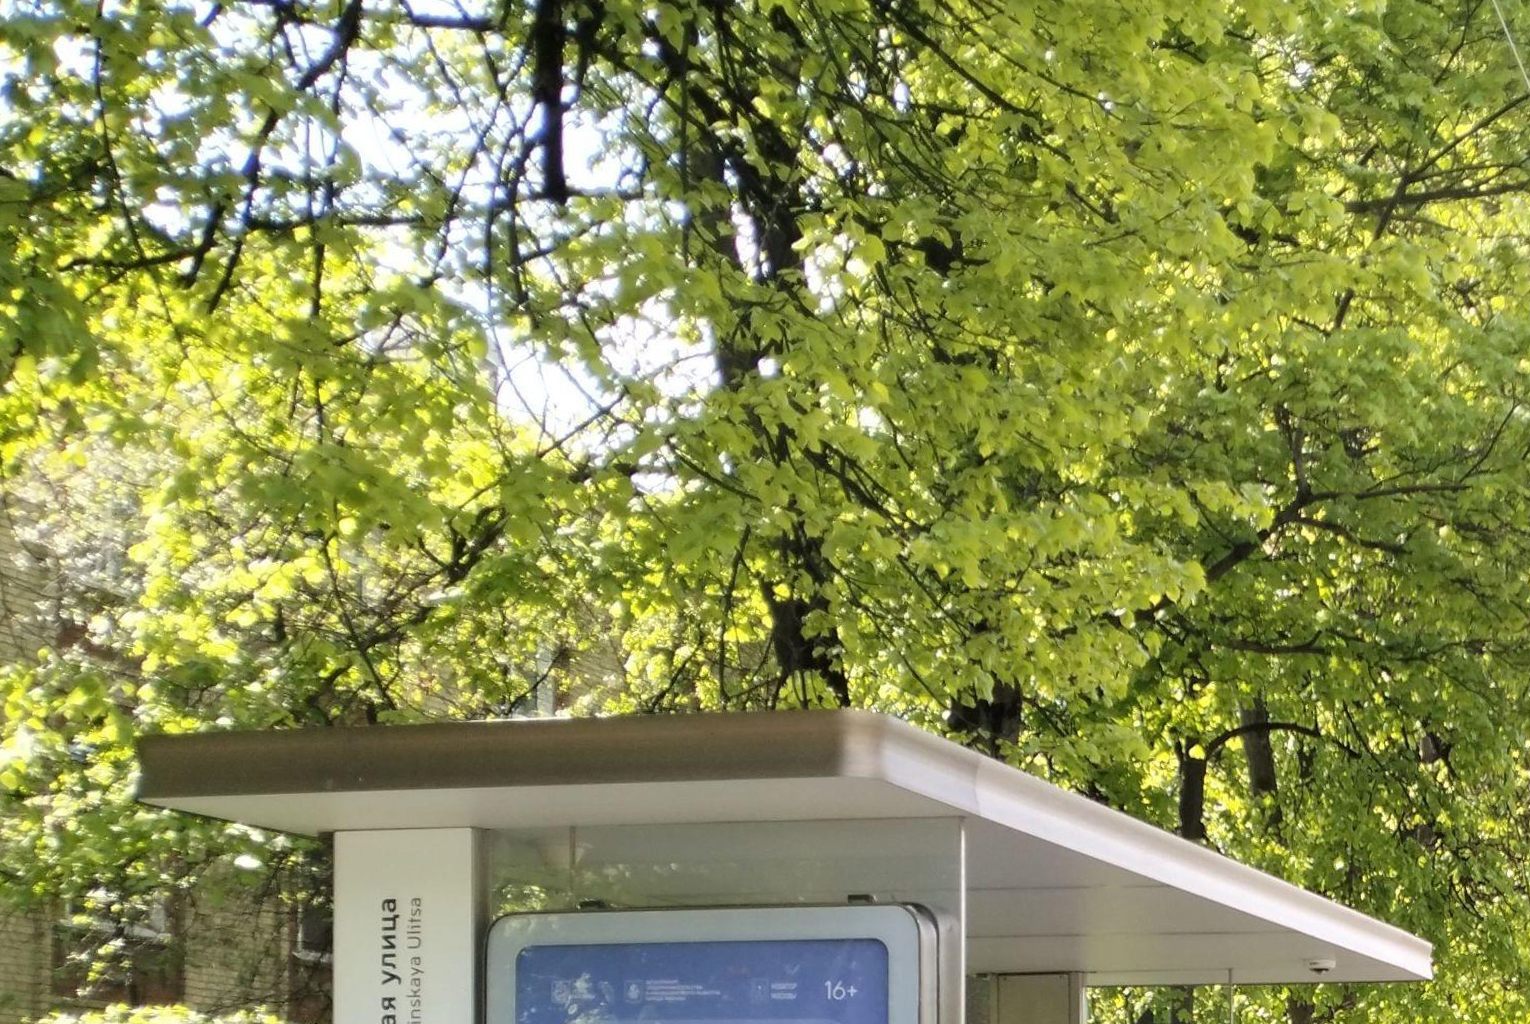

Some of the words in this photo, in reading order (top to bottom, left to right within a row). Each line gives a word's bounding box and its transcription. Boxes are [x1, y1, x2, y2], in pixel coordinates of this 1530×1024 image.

[381, 897, 402, 985] улица
[406, 896, 422, 949] Ulitsa
[824, 980, 858, 1000] 16+
